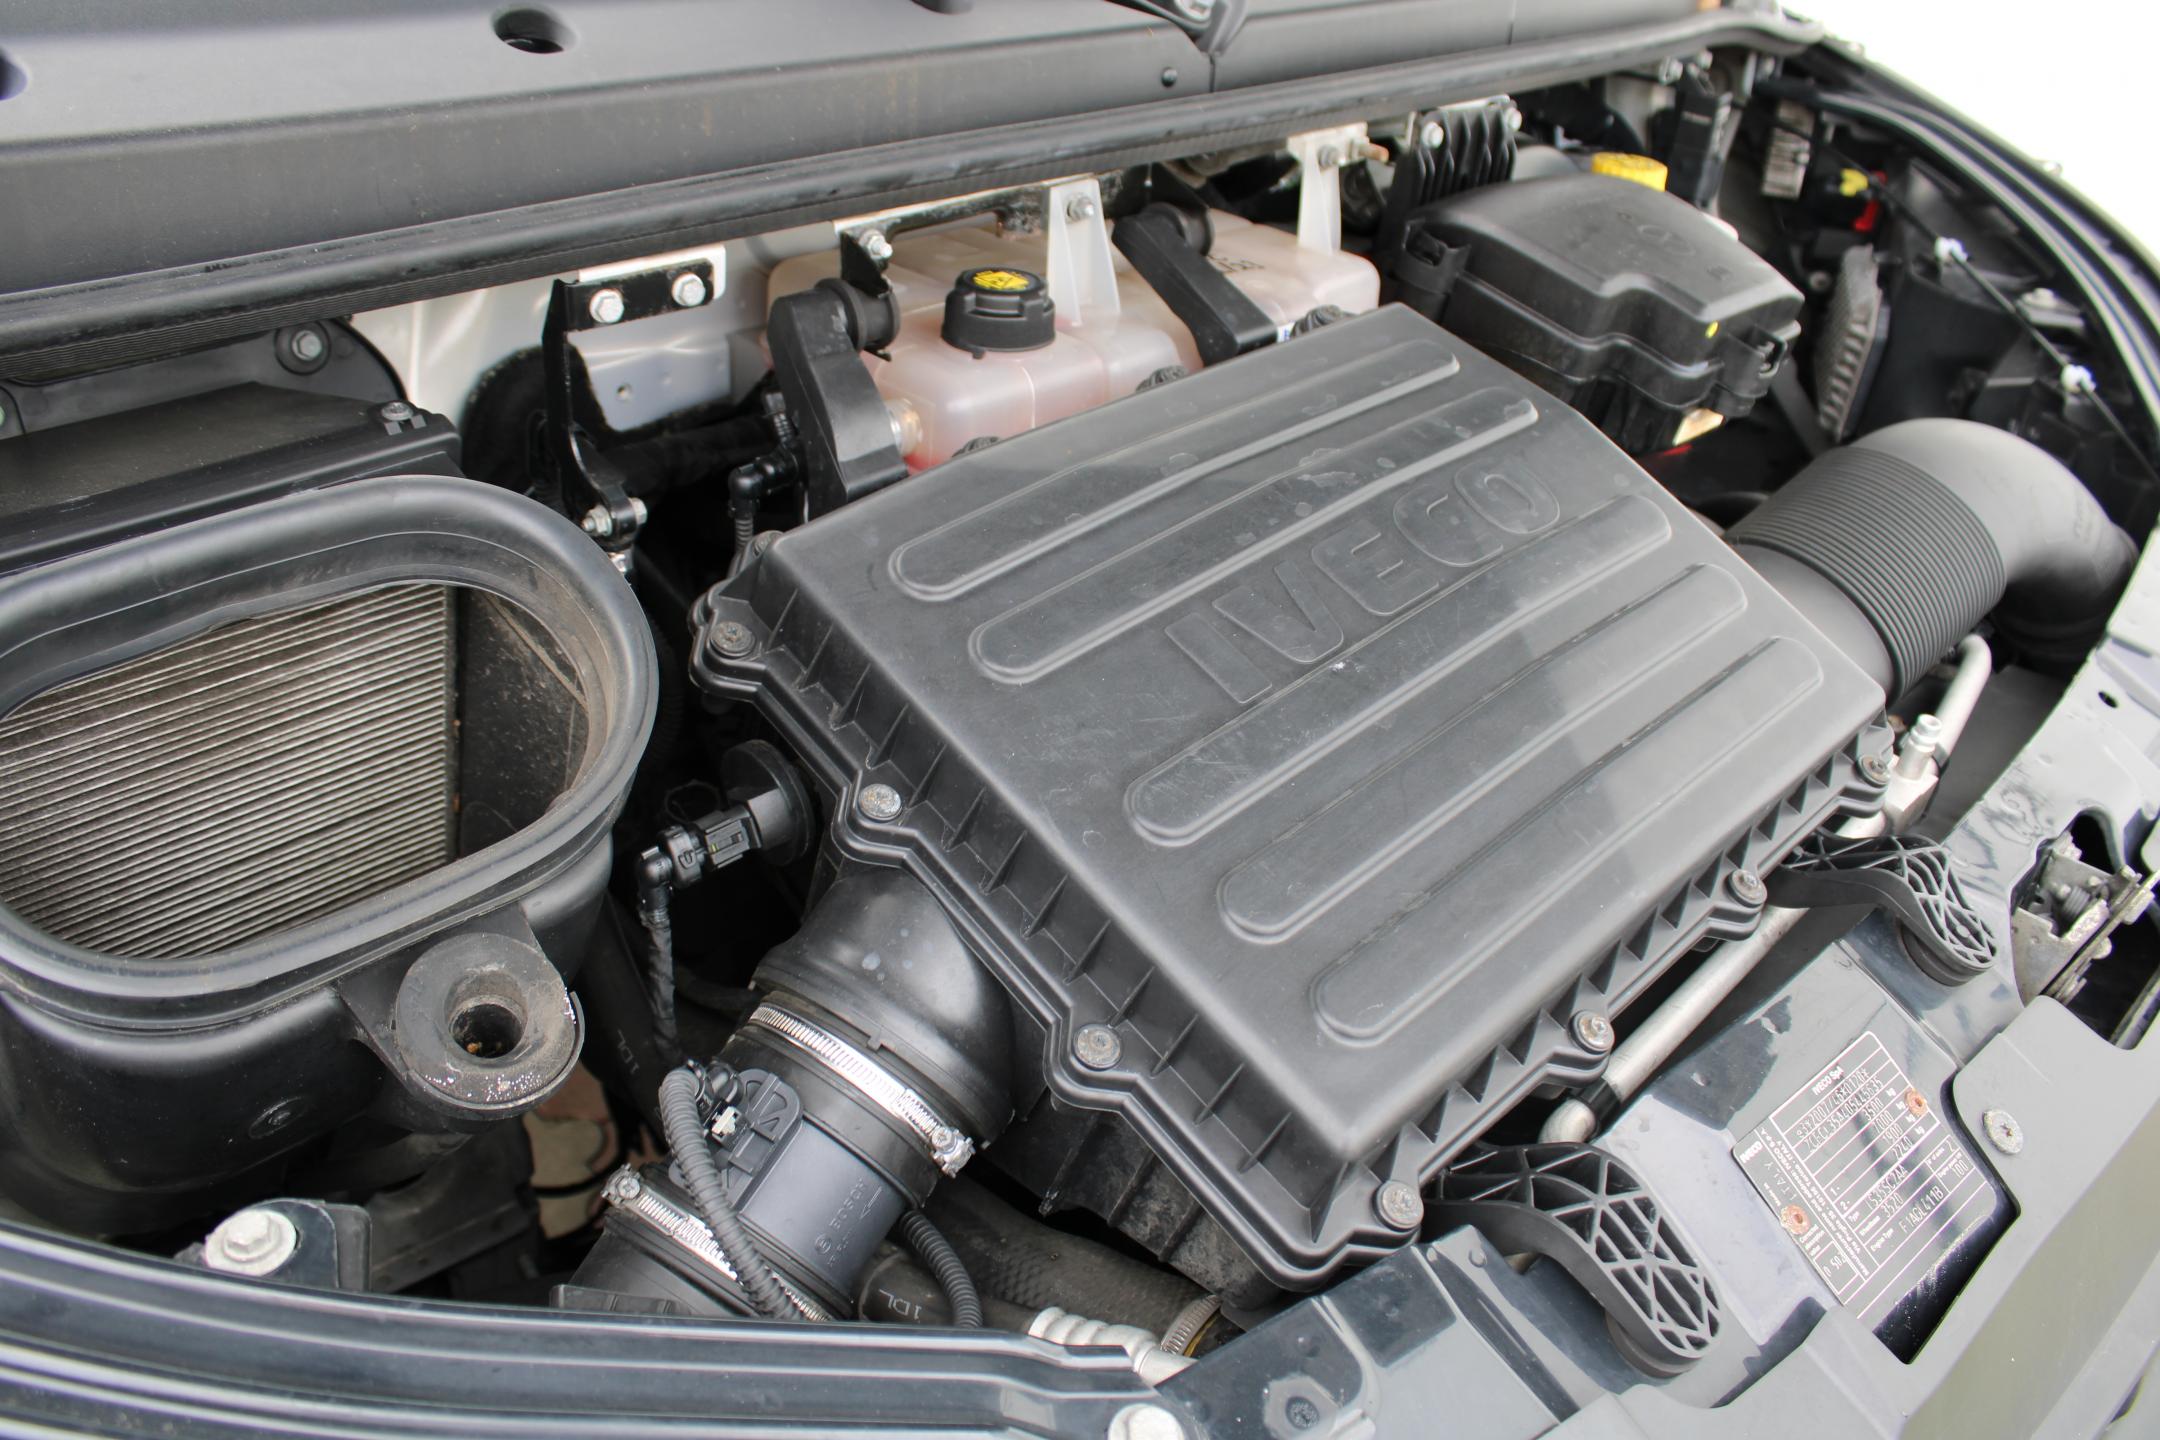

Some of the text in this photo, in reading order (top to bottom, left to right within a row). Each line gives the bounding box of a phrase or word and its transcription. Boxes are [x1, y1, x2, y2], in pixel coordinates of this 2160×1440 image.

[1163, 456, 1562, 704] IVECO
[1811, 1064, 1845, 1096] IVECO SpA
[1861, 1085, 1897, 1121] 3500 kg
[1871, 1108, 1895, 1134] 7000
[1881, 1121, 1904, 1147] 1900
[1738, 1138, 1763, 1165] IVECO
[1772, 1146, 1792, 1170] IVECO
[1775, 1138, 1794, 1161] ITALY
[1890, 1135, 1913, 1161] 2240
[1762, 1157, 1798, 1202] ITALY
[1951, 1158, 1969, 1179] 100
[1880, 1190, 1904, 1218] 3520
